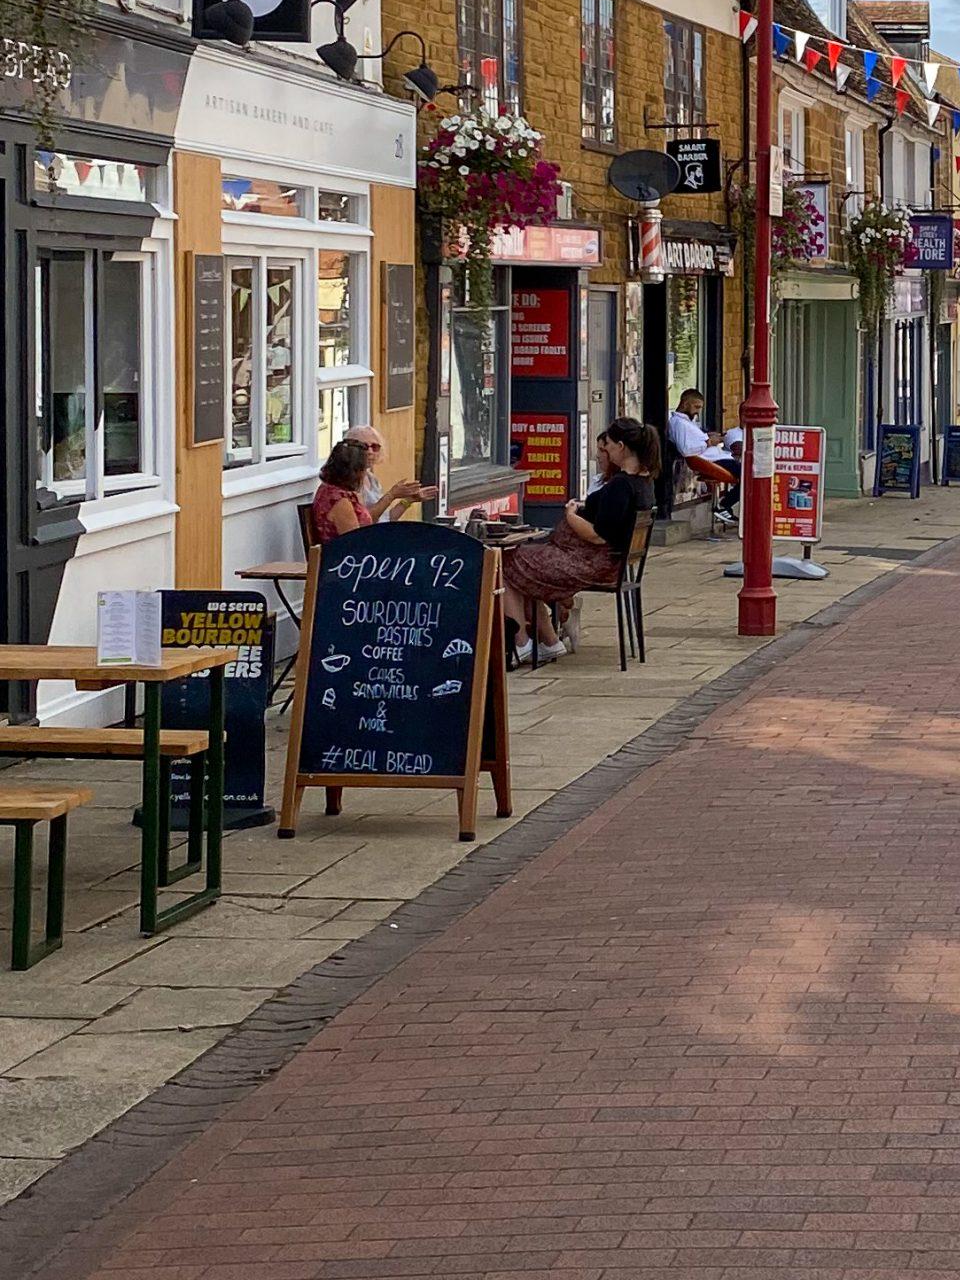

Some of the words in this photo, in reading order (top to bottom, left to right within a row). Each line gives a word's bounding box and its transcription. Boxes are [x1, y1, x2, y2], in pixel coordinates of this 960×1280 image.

[205, 94, 249, 117] ARTISAN
[253, 105, 289, 126] BAKERY
[291, 115, 311, 131] AND
[678, 144, 706, 152] SMART
[677, 153, 708, 162] BARBER
[683, 242, 716, 270] BARBER
[919, 248, 946, 261] TORE
[518, 323, 552, 332] SCREENS
[536, 423, 565, 433] REPAIR
[527, 437, 562, 447] MOBILES
[527, 453, 560, 463] TABLETS
[775, 446, 804, 460] ORLD
[328, 554, 416, 593] open
[430, 554, 465, 591] 9-2
[207, 602, 227, 611] we
[228, 602, 264, 611] serve
[341, 600, 442, 628] SOURDOUGH
[180, 612, 264, 629] YELLOW
[162, 628, 263, 645] BOURBON
[376, 626, 434, 648] PASTRIES
[361, 644, 404, 662] COFFEE
[367, 666, 406, 684] CAKES
[375, 700, 388, 719] &
[386, 750, 433, 775] BREAD
